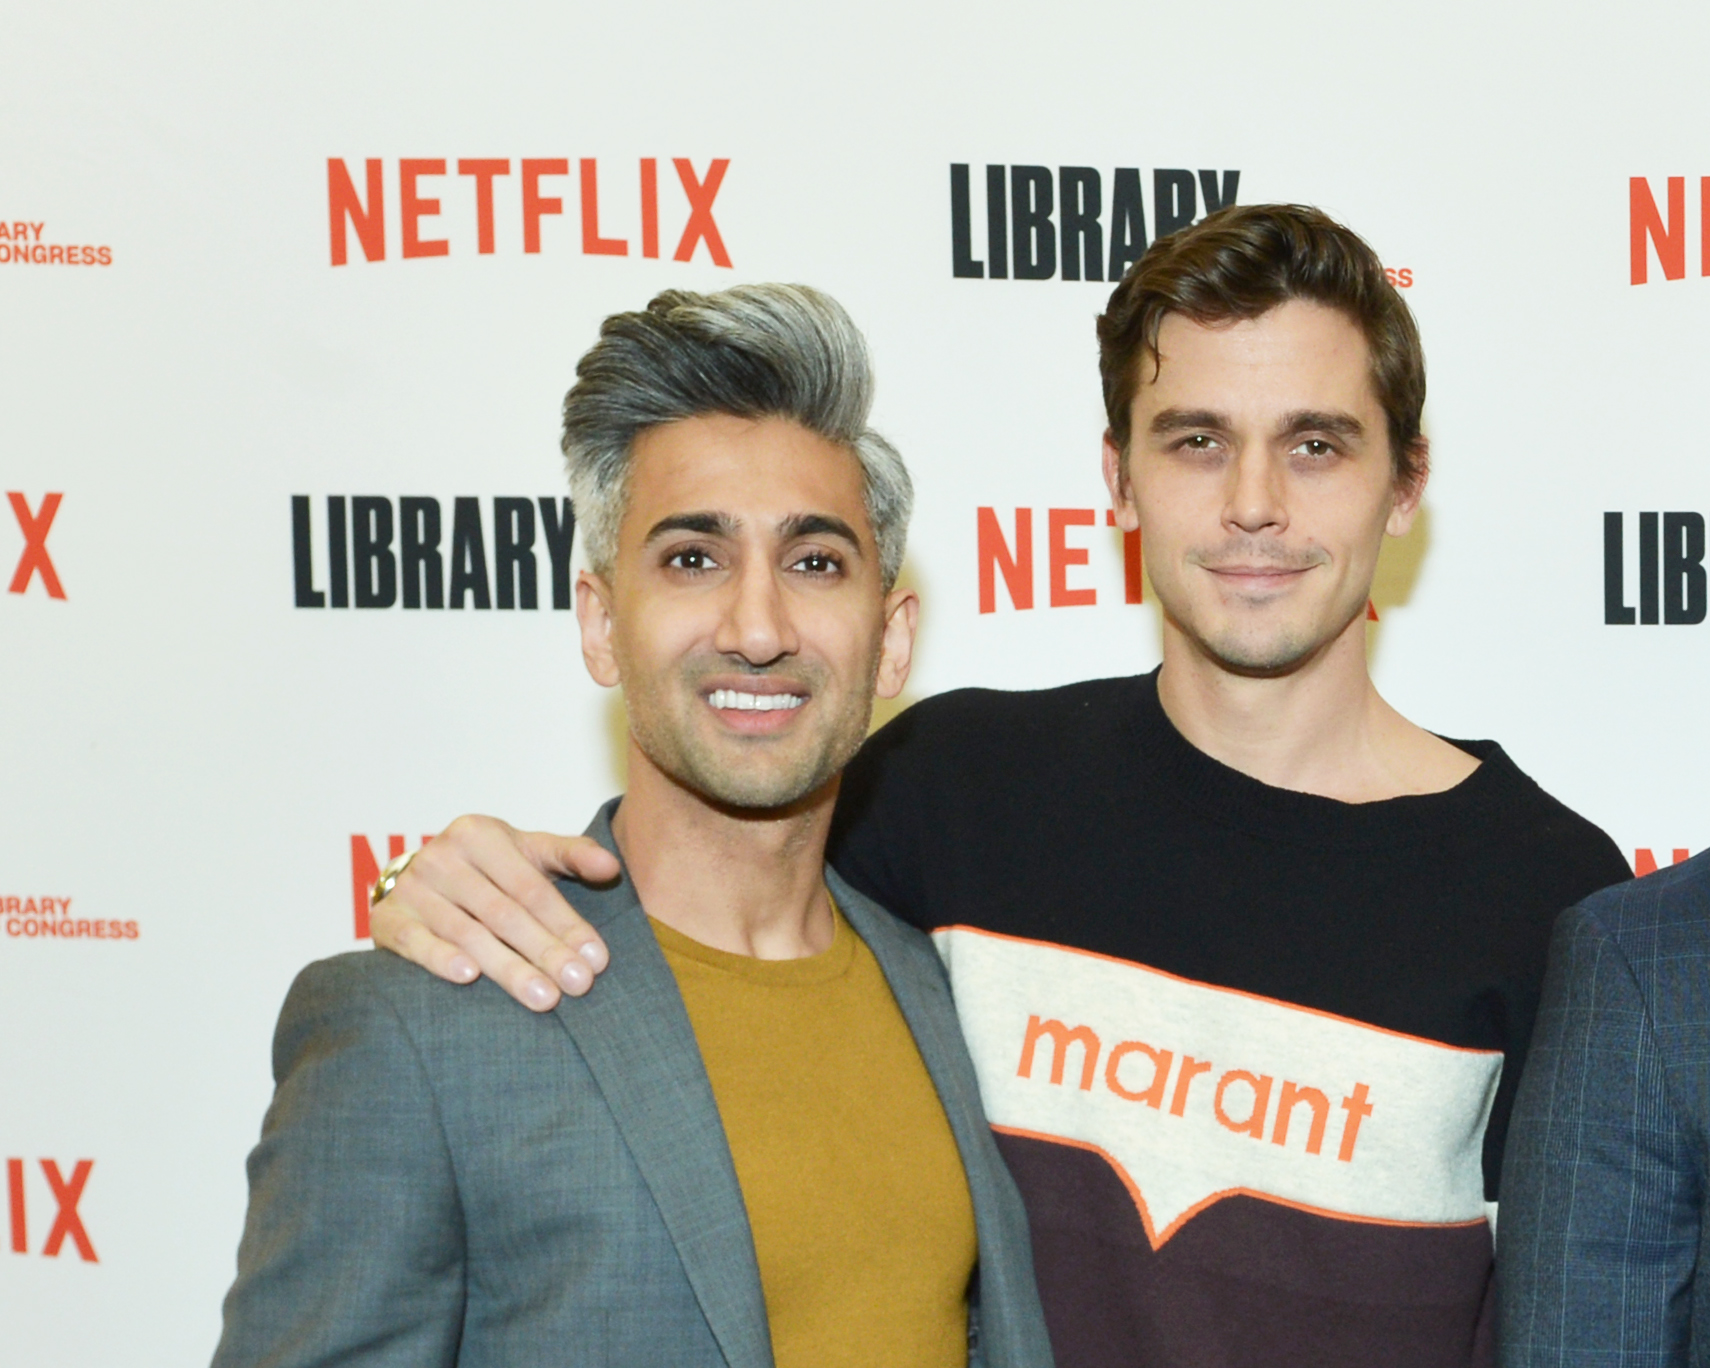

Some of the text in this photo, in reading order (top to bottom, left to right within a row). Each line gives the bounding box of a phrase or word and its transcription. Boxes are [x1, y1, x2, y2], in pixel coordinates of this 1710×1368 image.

[0, 244, 113, 266] ONGRESS
[326, 157, 734, 269] NETFLIX
[292, 495, 577, 610] LIBRARY
[6, 918, 139, 940] CONGRESS
[1016, 1013, 1374, 1162] marant
